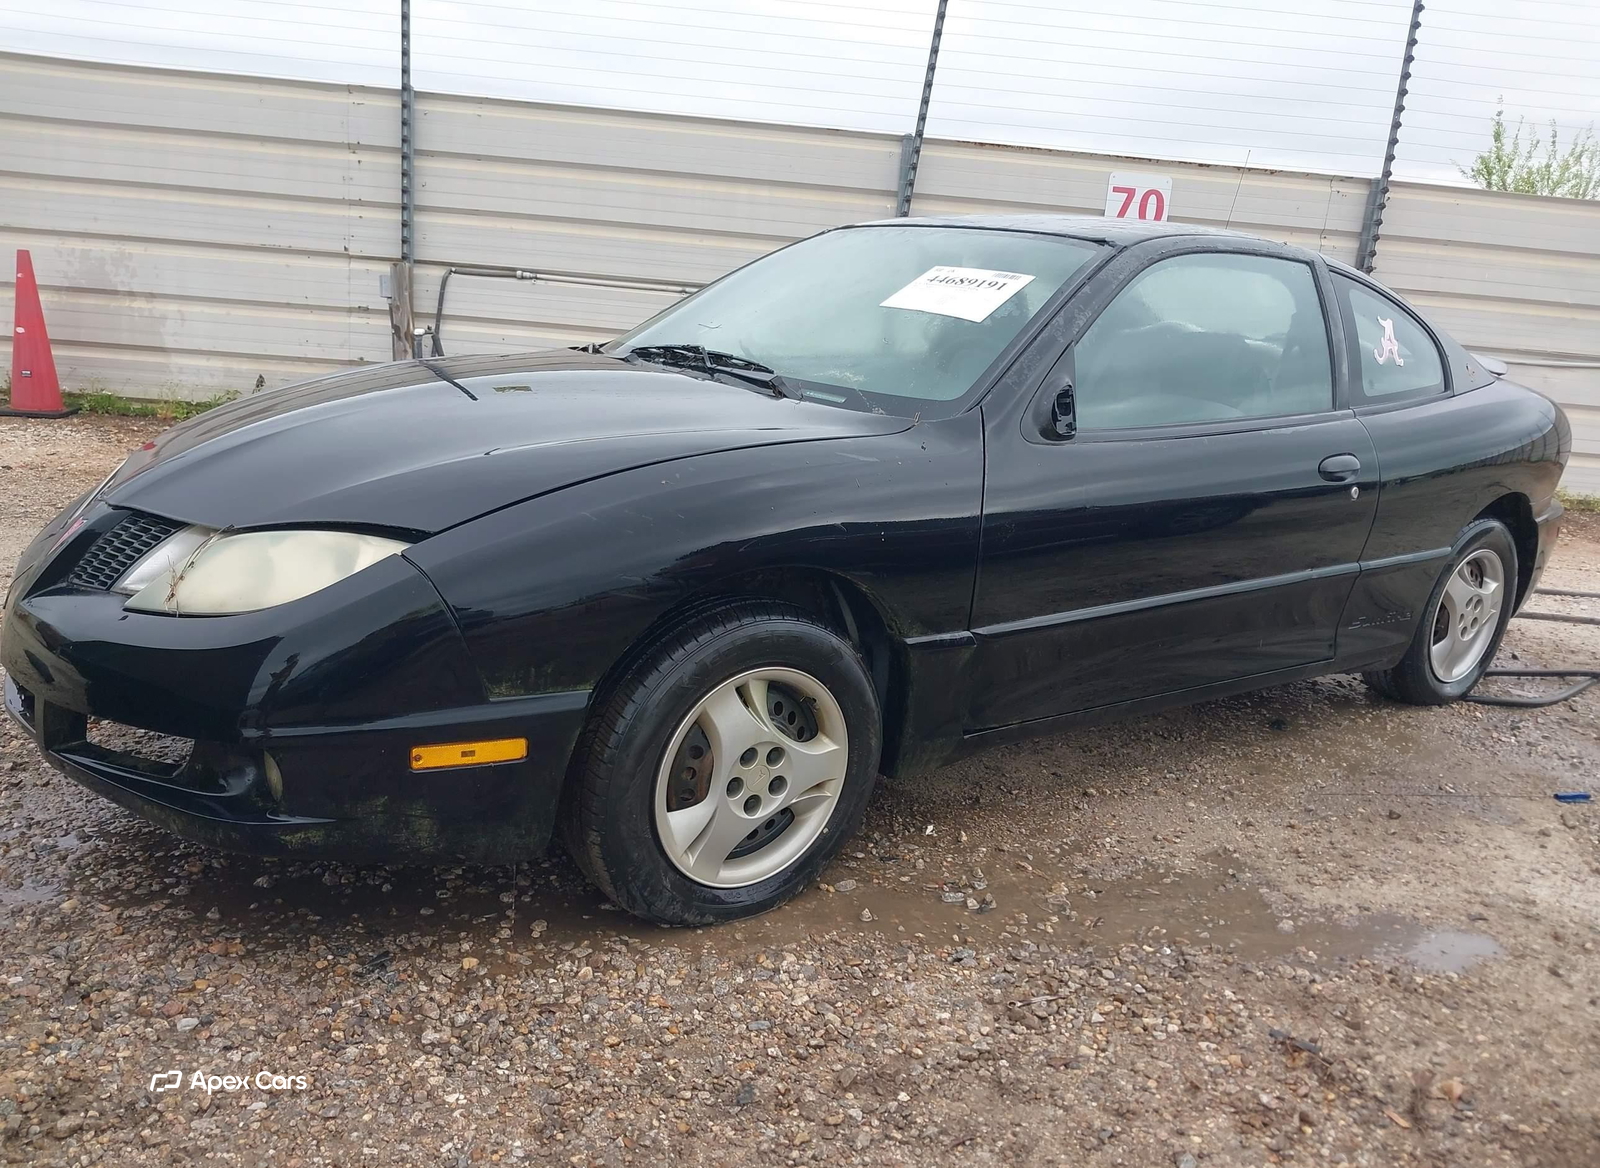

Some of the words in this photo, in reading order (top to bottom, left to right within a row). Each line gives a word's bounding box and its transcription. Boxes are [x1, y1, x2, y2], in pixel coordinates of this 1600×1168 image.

[1112, 186, 1165, 222] 70
[927, 275, 1008, 291] 44689191
[1374, 315, 1404, 367] A
